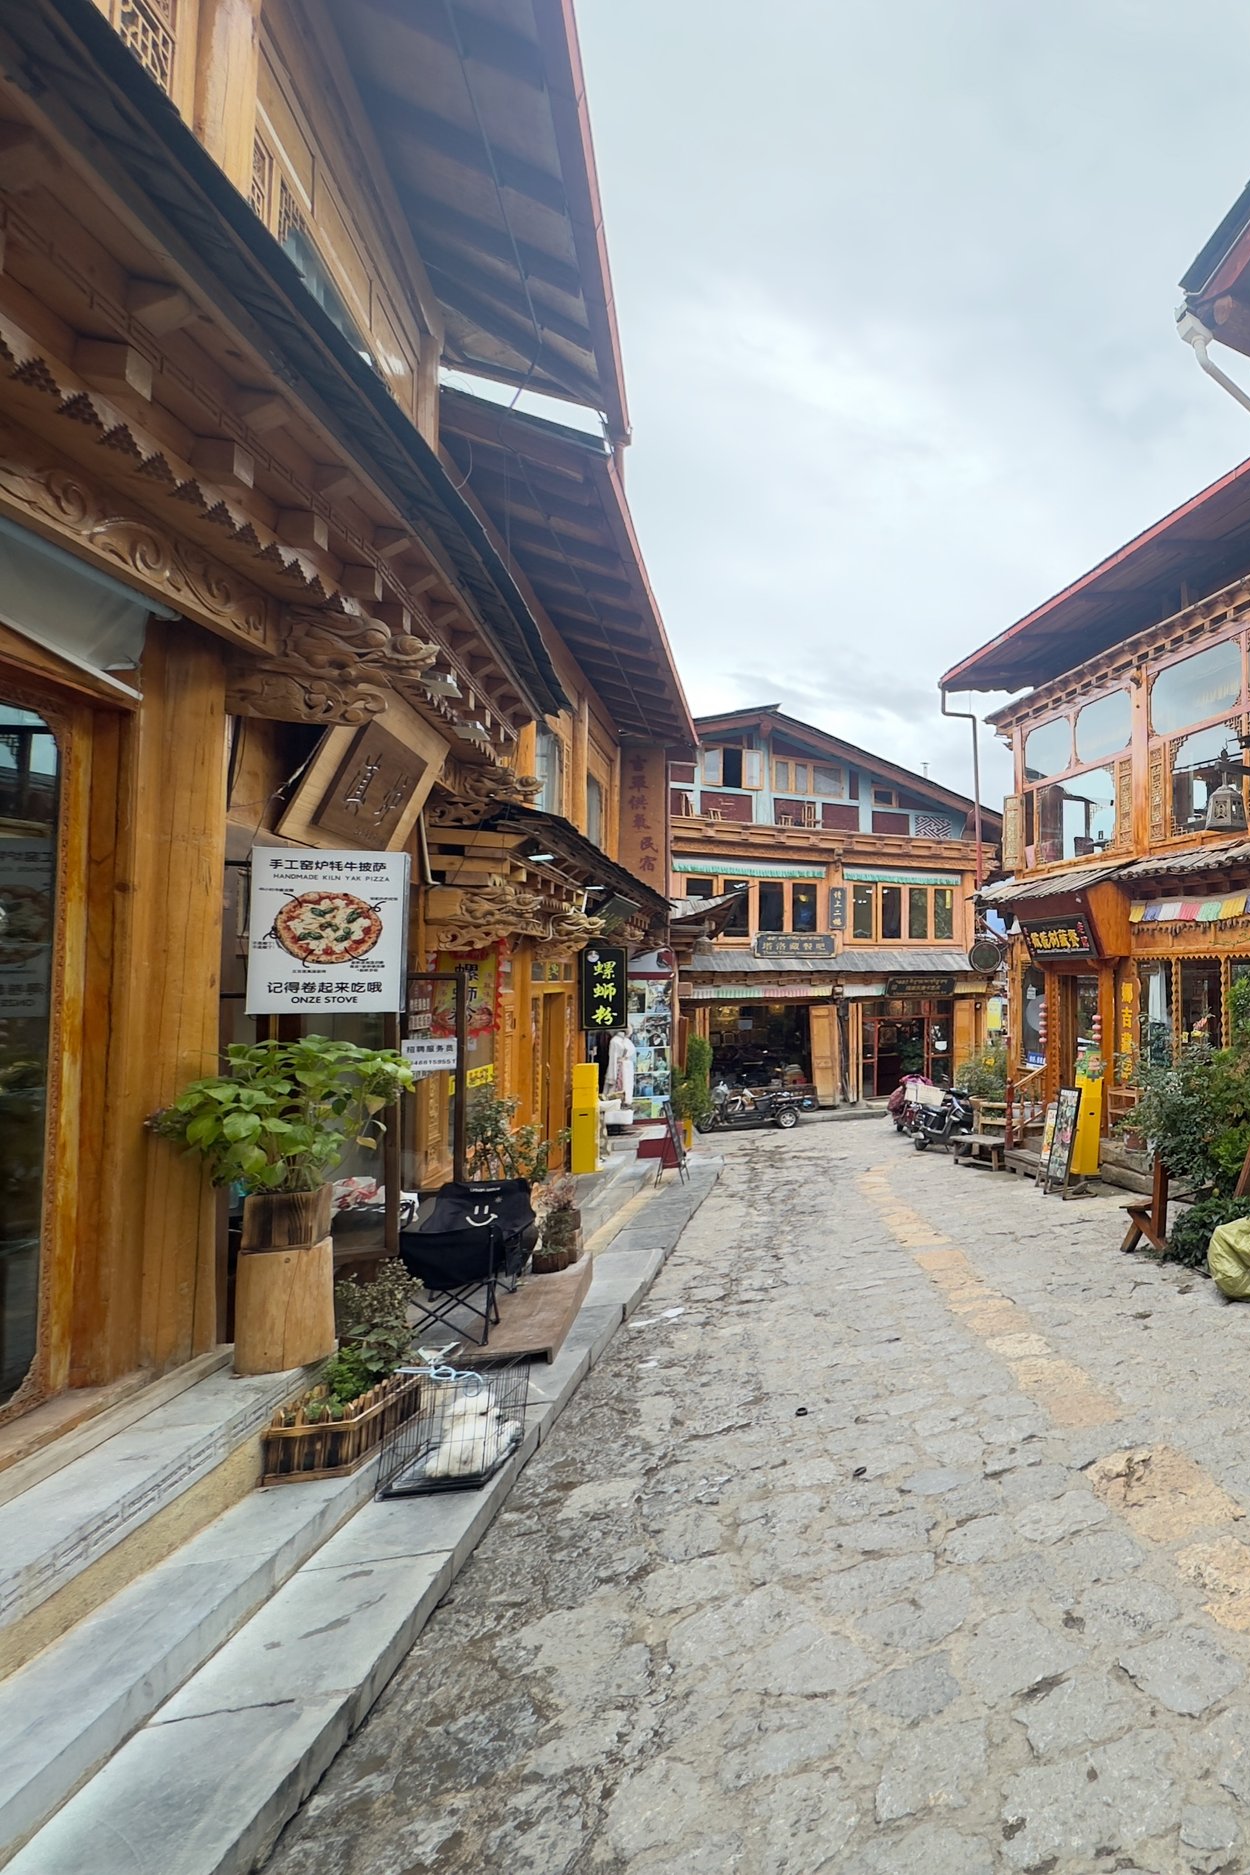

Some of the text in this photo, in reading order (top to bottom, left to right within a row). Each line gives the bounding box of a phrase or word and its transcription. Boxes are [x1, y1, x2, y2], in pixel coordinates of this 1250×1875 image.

[269, 859, 387, 872] 手工窑炉牦牛披萨
[267, 982, 382, 994] 记得卷起来吃哦
[591, 961, 617, 1026] 螺蛳粉
[291, 996, 358, 1004] ONZE STOVE
[406, 1044, 454, 1053] 招聘服务员
